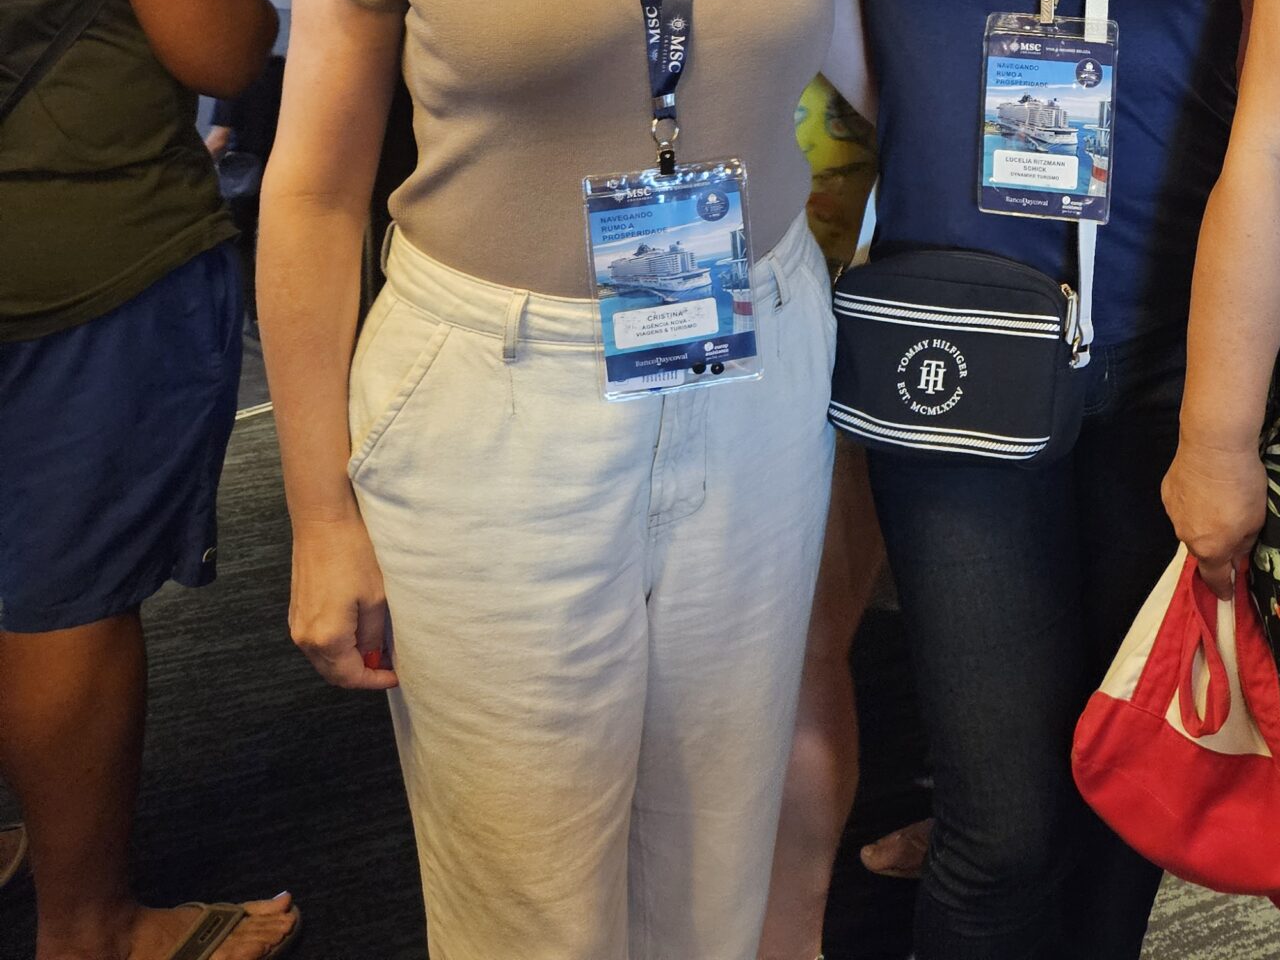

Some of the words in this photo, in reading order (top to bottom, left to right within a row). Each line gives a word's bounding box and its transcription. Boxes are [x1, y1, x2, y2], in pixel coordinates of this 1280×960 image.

[646, 6, 661, 44] MSC
[1020, 43, 1042, 51] MSC
[668, 35, 686, 74] MSC
[996, 62, 1039, 71] NAVEGANDO
[996, 70, 1017, 78] RUMO
[995, 79, 1049, 88] PROSPERIDADE
[1033, 159, 1066, 167] RITZMANN
[1023, 165, 1047, 173] SCHICK
[626, 187, 652, 199] MSC
[600, 210, 653, 224] NAVEGANDO
[601, 223, 627, 233] RUMO
[601, 227, 667, 241] PROSPERIDADE
[647, 311, 683, 322] CRISTINA
[636, 328, 663, 337] VIAGENS
[670, 323, 698, 332] TURISMO
[897, 339, 930, 373] TOMMY
[932, 338, 968, 379] HILFIGER
[896, 381, 911, 404] EST.
[910, 386, 963, 416] MCMLXXXV
